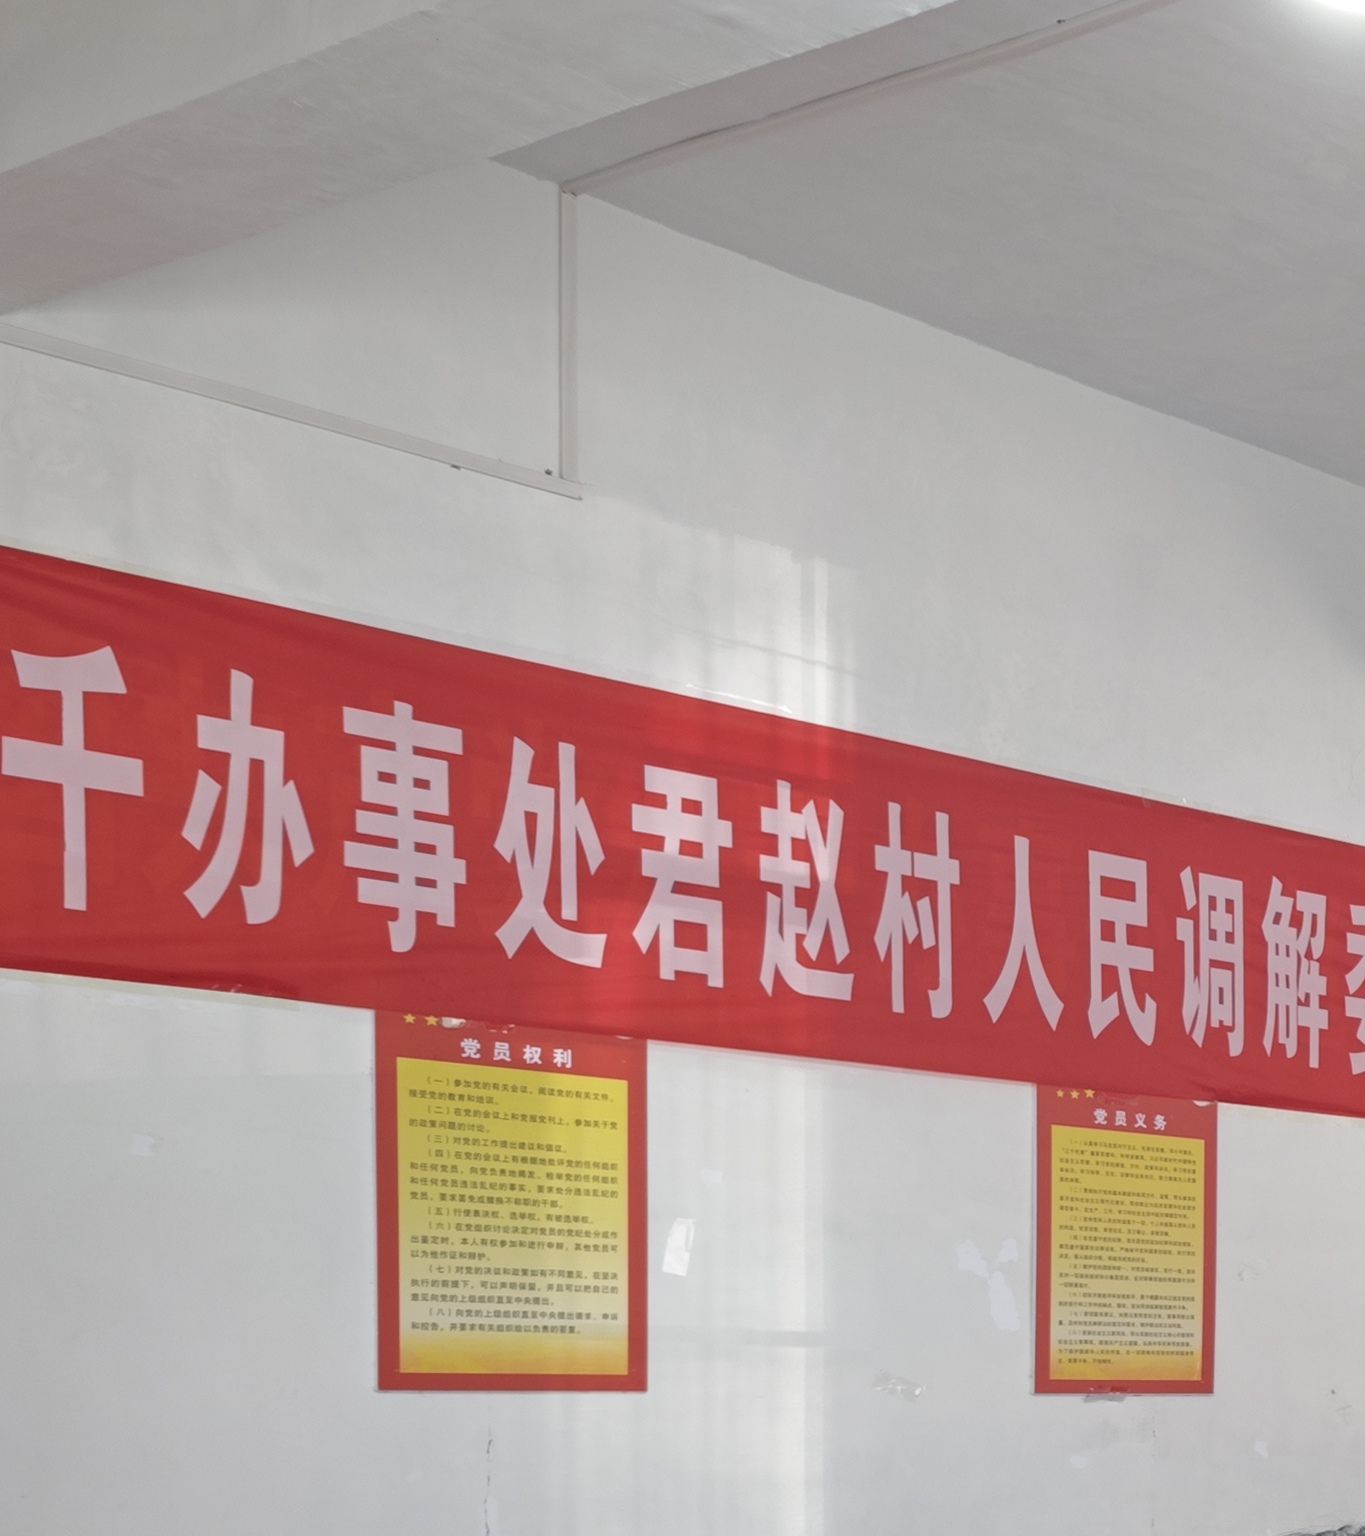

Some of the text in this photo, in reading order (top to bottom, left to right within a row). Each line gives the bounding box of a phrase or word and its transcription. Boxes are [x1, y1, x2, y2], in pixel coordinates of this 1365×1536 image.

[461, 1039, 572, 1068] 党员权利
[1094, 1108, 1167, 1130] 党员义务
